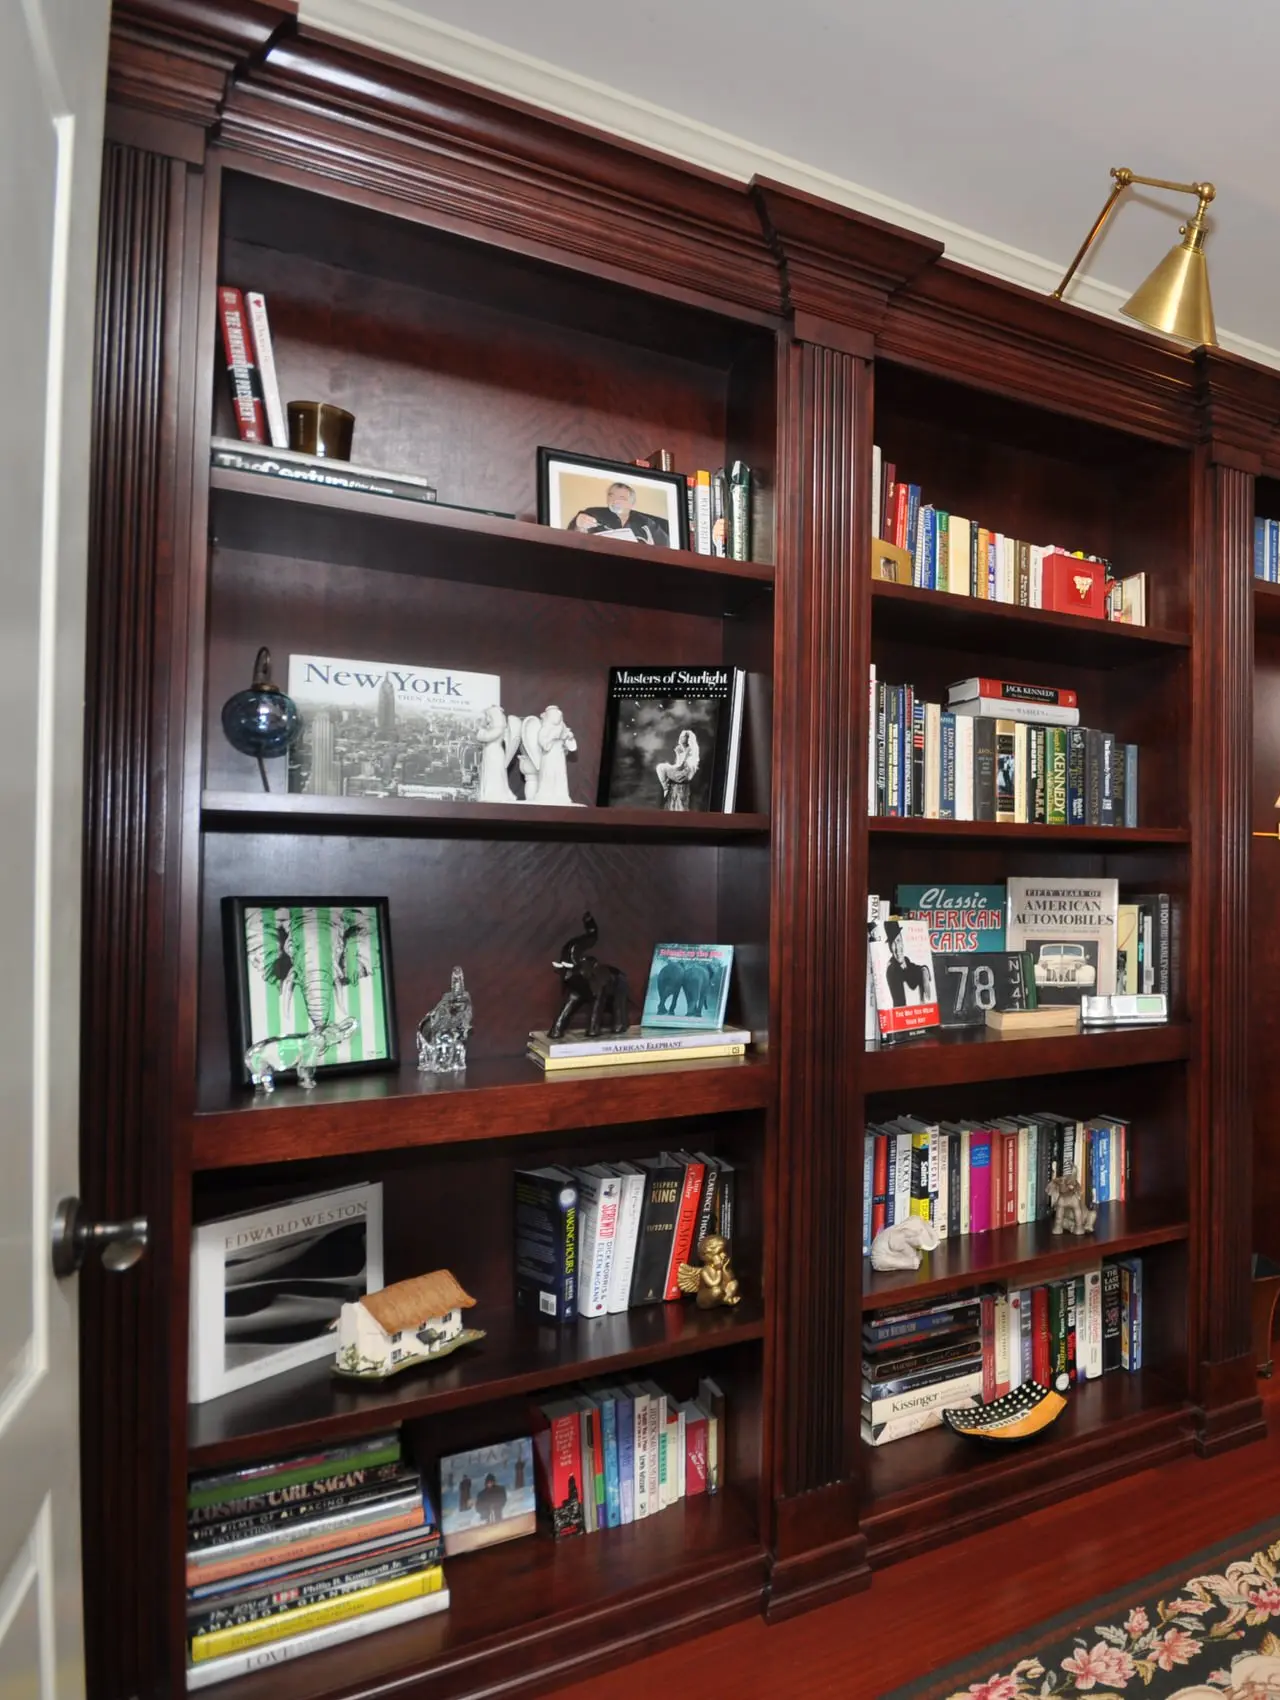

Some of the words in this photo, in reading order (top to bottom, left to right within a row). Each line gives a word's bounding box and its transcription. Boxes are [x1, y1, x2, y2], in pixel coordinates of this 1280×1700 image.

[304, 663, 383, 690] New
[388, 671, 464, 698] York
[615, 671, 661, 684] Masters
[662, 671, 676, 684] of
[677, 670, 728, 687] Starlight
[1005, 684, 1022, 695] JACK
[1023, 687, 1055, 698] KENNEDY
[877, 712, 886, 739] History
[948, 749, 954, 759] ME
[876, 776, 885, 789] Life
[1054, 752, 1066, 814] KENNEDY
[871, 895, 880, 922] FRAN
[919, 887, 988, 910] Classic
[1024, 900, 1102, 912] AMERICAN
[908, 909, 1002, 931] AMERICAN
[1015, 914, 1115, 926] AUTOMOBILES
[929, 932, 979, 951] CARS
[947, 966, 996, 1012] 78
[922, 1007, 934, 1015] WEAR
[612, 1042, 645, 1053] AFRICAN
[645, 1040, 683, 1051] ELEPHANT
[902, 1149, 911, 1192] IACOCCA
[921, 1161, 929, 1187] Saints
[652, 1181, 679, 1190] STEPHEN
[652, 1189, 677, 1203] KING
[703, 1172, 719, 1213] CLARENCE
[225, 1219, 300, 1250] EDWARD
[301, 1201, 370, 1227] WESTON
[565, 1207, 576, 1243] WAKING
[600, 1203, 617, 1240] SCREWED!
[697, 1214, 712, 1247] THOM
[675, 1210, 693, 1267] DEMONI
[565, 1243, 575, 1274] HOURS
[597, 1243, 605, 1269] EILEEN
[602, 1261, 611, 1293] MORRIS
[1104, 1276, 1119, 1285] LAST
[1107, 1270, 1118, 1278] THE
[1104, 1283, 1120, 1292] LION
[1021, 1299, 1031, 1330] LIT
[891, 1392, 940, 1413] Kissinger
[978, 1409, 1030, 1431] COHIBA
[268, 1483, 311, 1506] CARL
[312, 1470, 366, 1495] SAGAN
[193, 1526, 214, 1540] THE
[221, 1517, 254, 1533] FILMS
[260, 1513, 273, 1524] OF
[300, 1498, 344, 1514] PACINO
[209, 1609, 231, 1622] The
[302, 1580, 332, 1596] Philip
[197, 1609, 272, 1635] AMADEO
